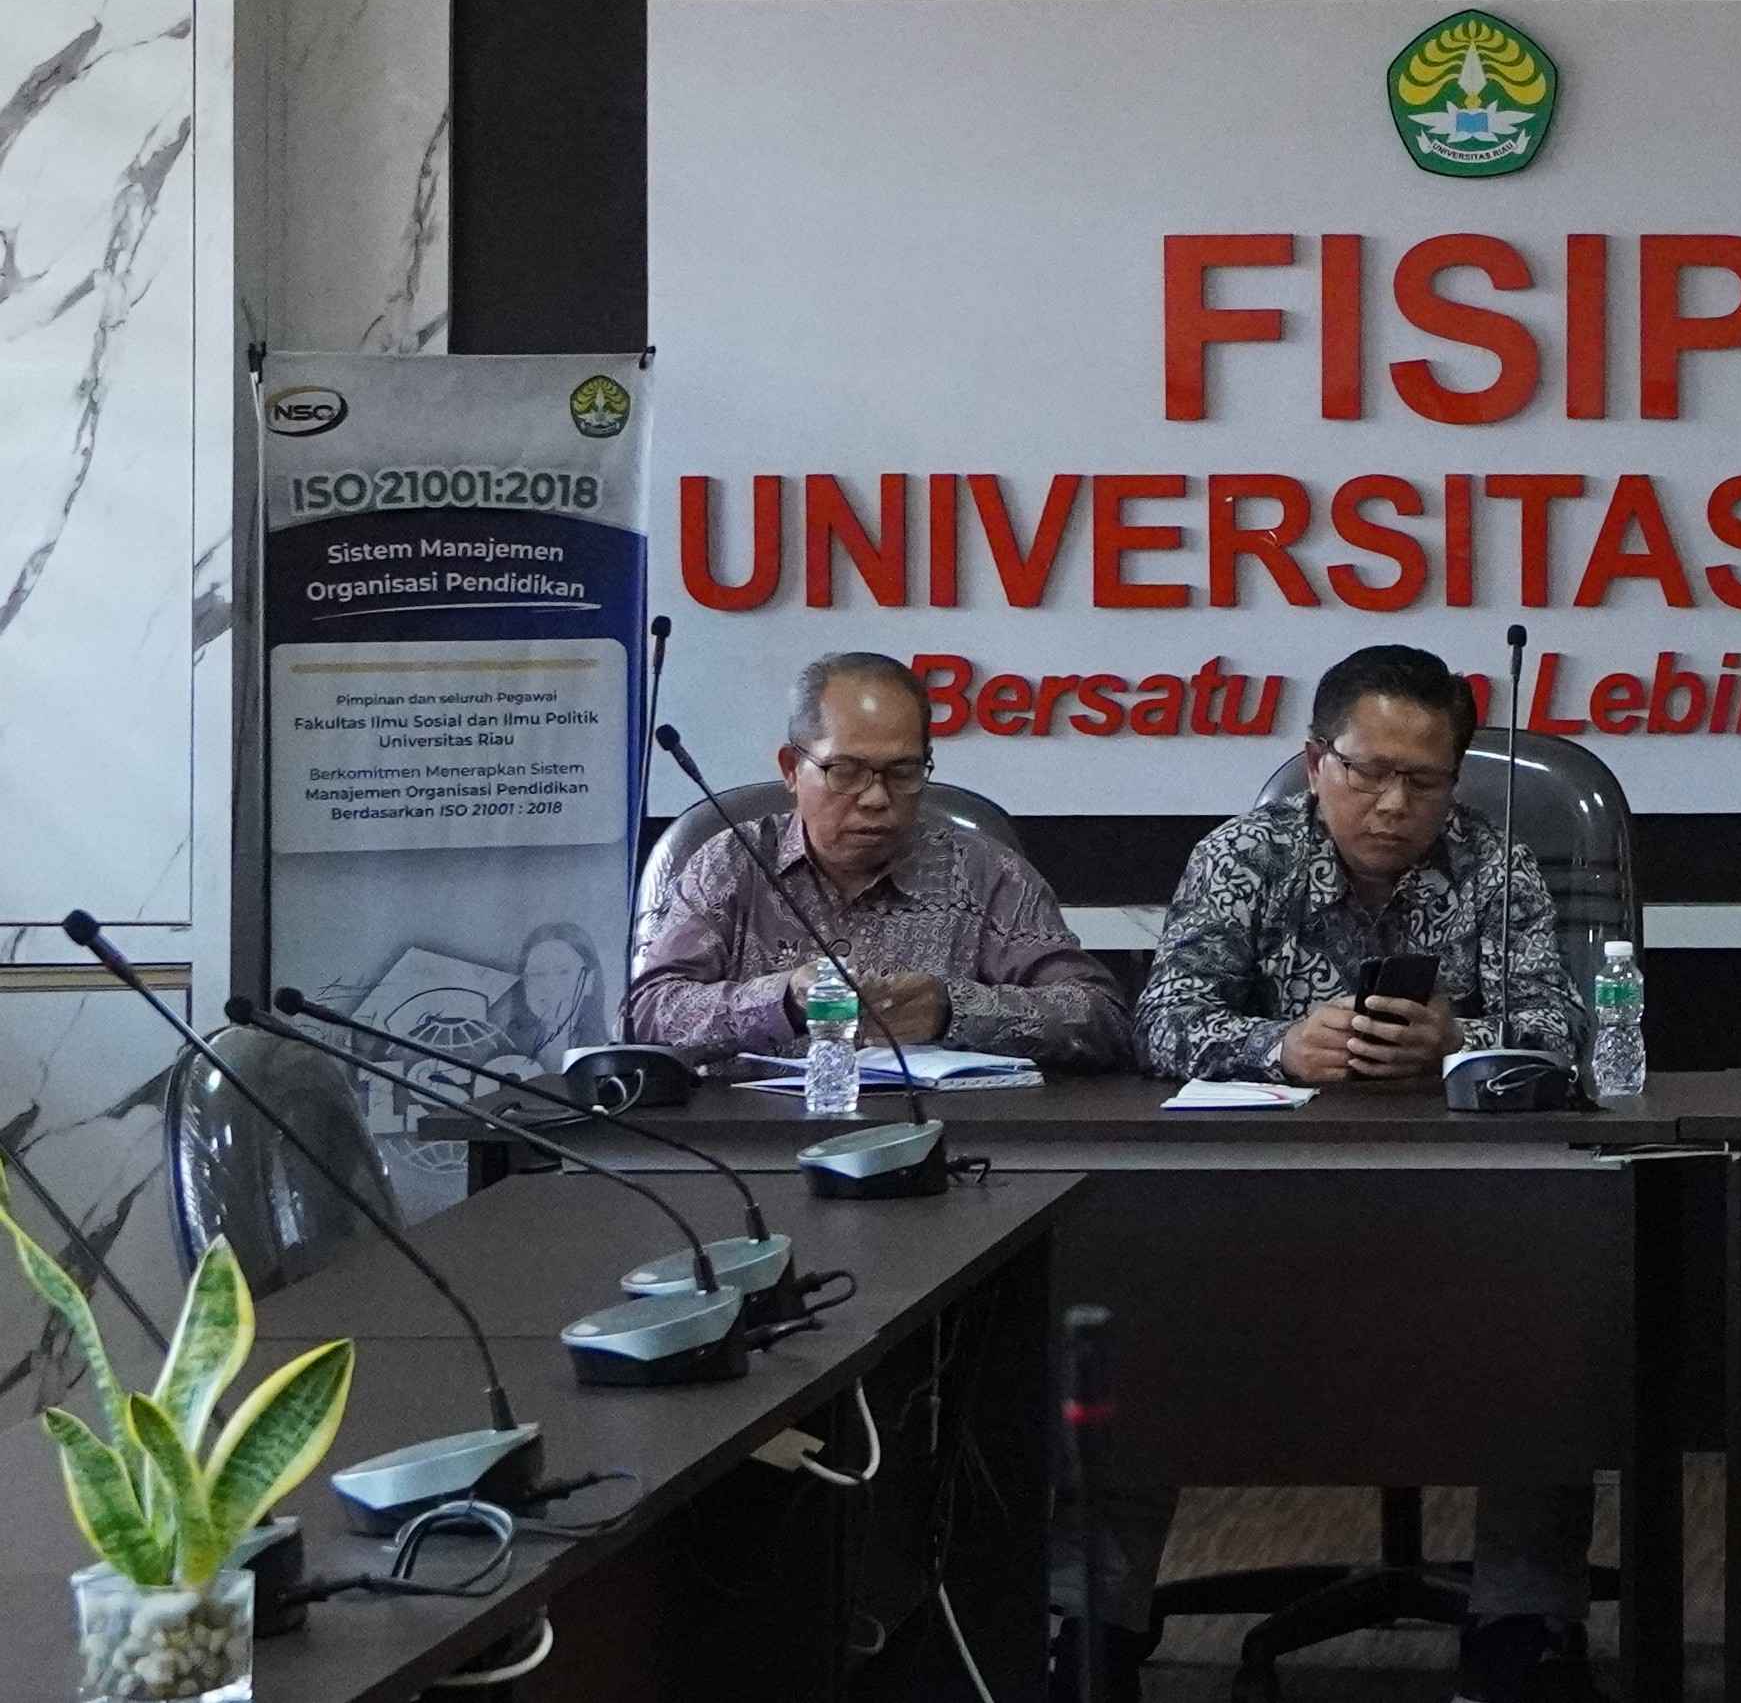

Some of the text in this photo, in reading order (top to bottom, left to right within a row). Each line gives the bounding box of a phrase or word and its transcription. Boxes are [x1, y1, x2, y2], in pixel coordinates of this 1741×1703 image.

[1433, 143, 1514, 161] UNIVERSITAS RIAU
[293, 470, 600, 513] ISO 21001:2018
[327, 538, 565, 564] Sistem Manajemen
[306, 571, 586, 603] Organisasi Pendidikan
[336, 690, 558, 708] Pimpinan dan seluruh Pegawai
[911, 653, 1286, 738] Bersatu
[294, 710, 599, 731] Fakultas Ilmu Sosial dan Ilmu Politik
[379, 731, 515, 749] Universitas Riau
[309, 761, 585, 781] Berkomitmen Menerapkan Sistem
[305, 781, 590, 804] Manajemen Organisasi Pendidikan
[331, 806, 434, 820] Berdasarkan
[439, 804, 468, 817] ISO
[471, 803, 515, 817] 21001
[526, 801, 563, 815] 2018
